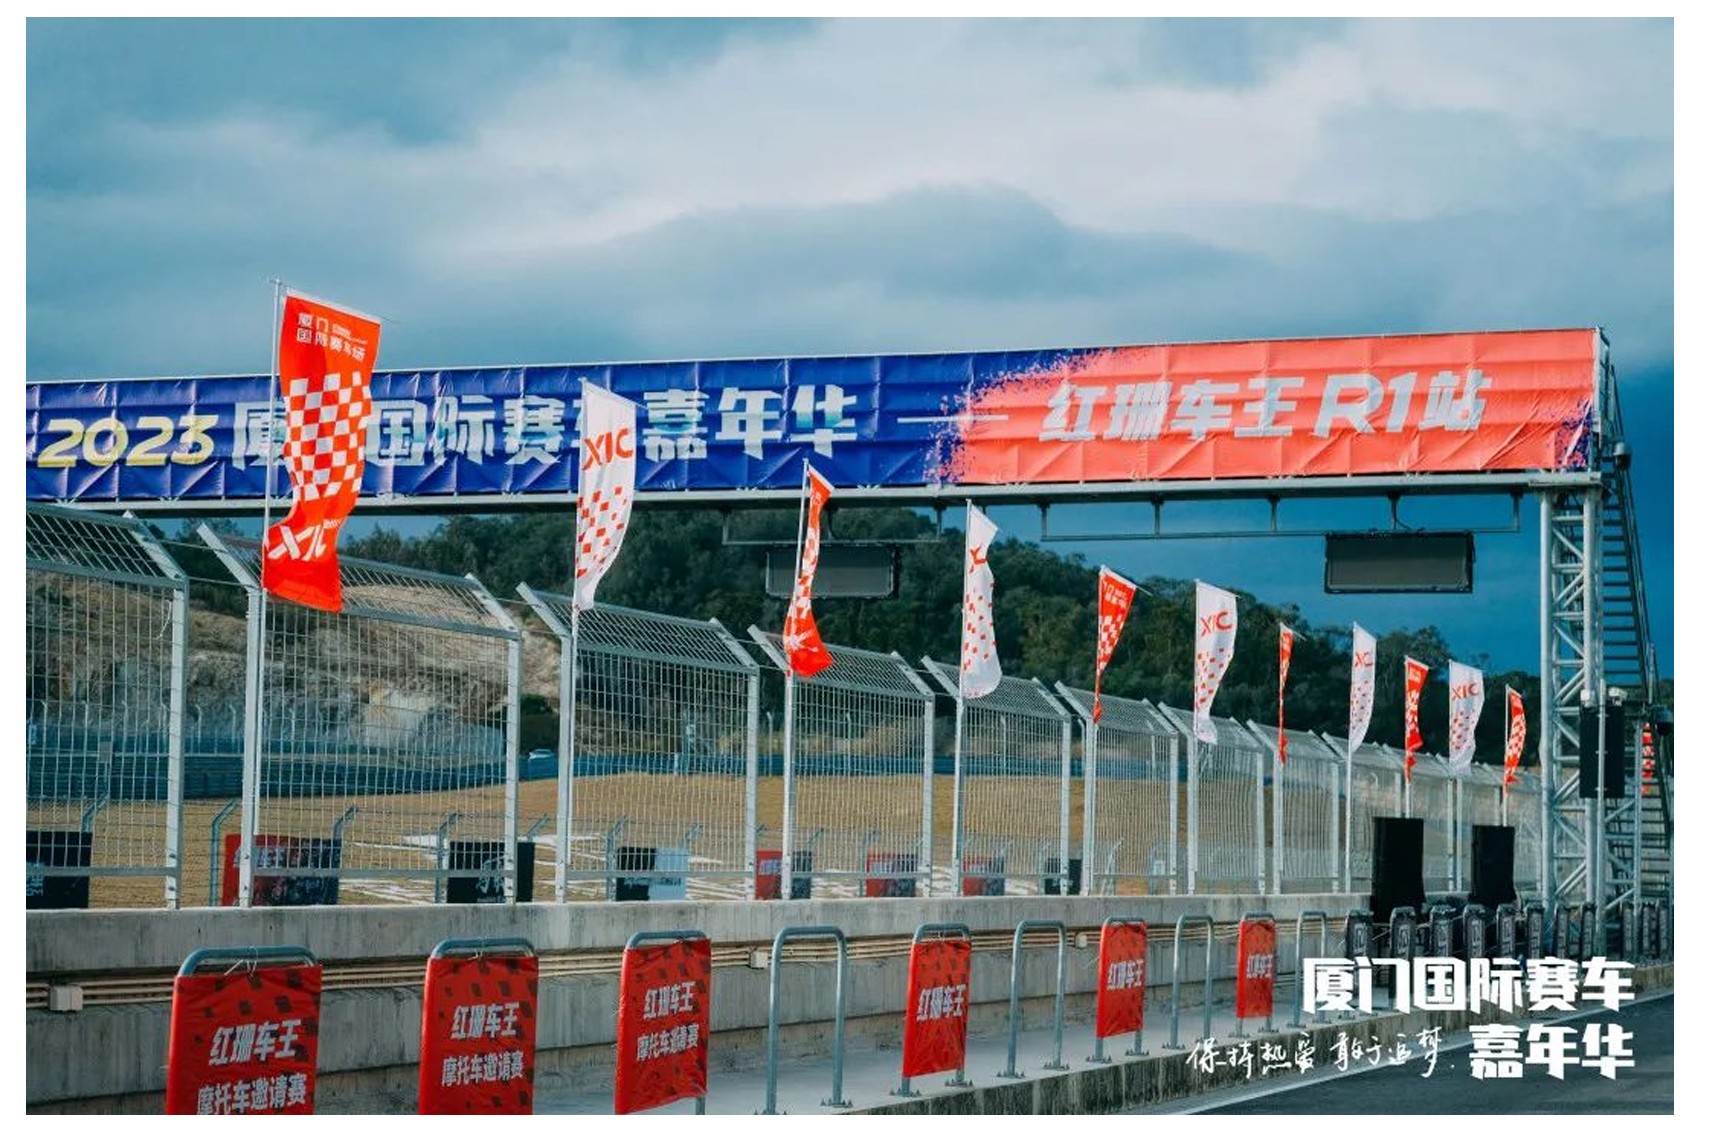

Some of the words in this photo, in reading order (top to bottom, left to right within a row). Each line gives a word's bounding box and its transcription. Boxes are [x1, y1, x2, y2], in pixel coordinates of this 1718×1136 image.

[37, 414, 219, 468] 2023
[232, 384, 858, 469] 厦国际赛嘉年华
[1039, 378, 1305, 442] 红珊车王
[1314, 368, 1492, 437] R1站
[582, 427, 634, 470] XIC
[1452, 682, 1480, 700] XIC
[208, 1018, 302, 1066] 红珊车王
[450, 1001, 520, 1040] 红珊车王
[441, 1050, 525, 1087] 摩托车邀请赛
[197, 1071, 308, 1115] 摩托车邀请赛
